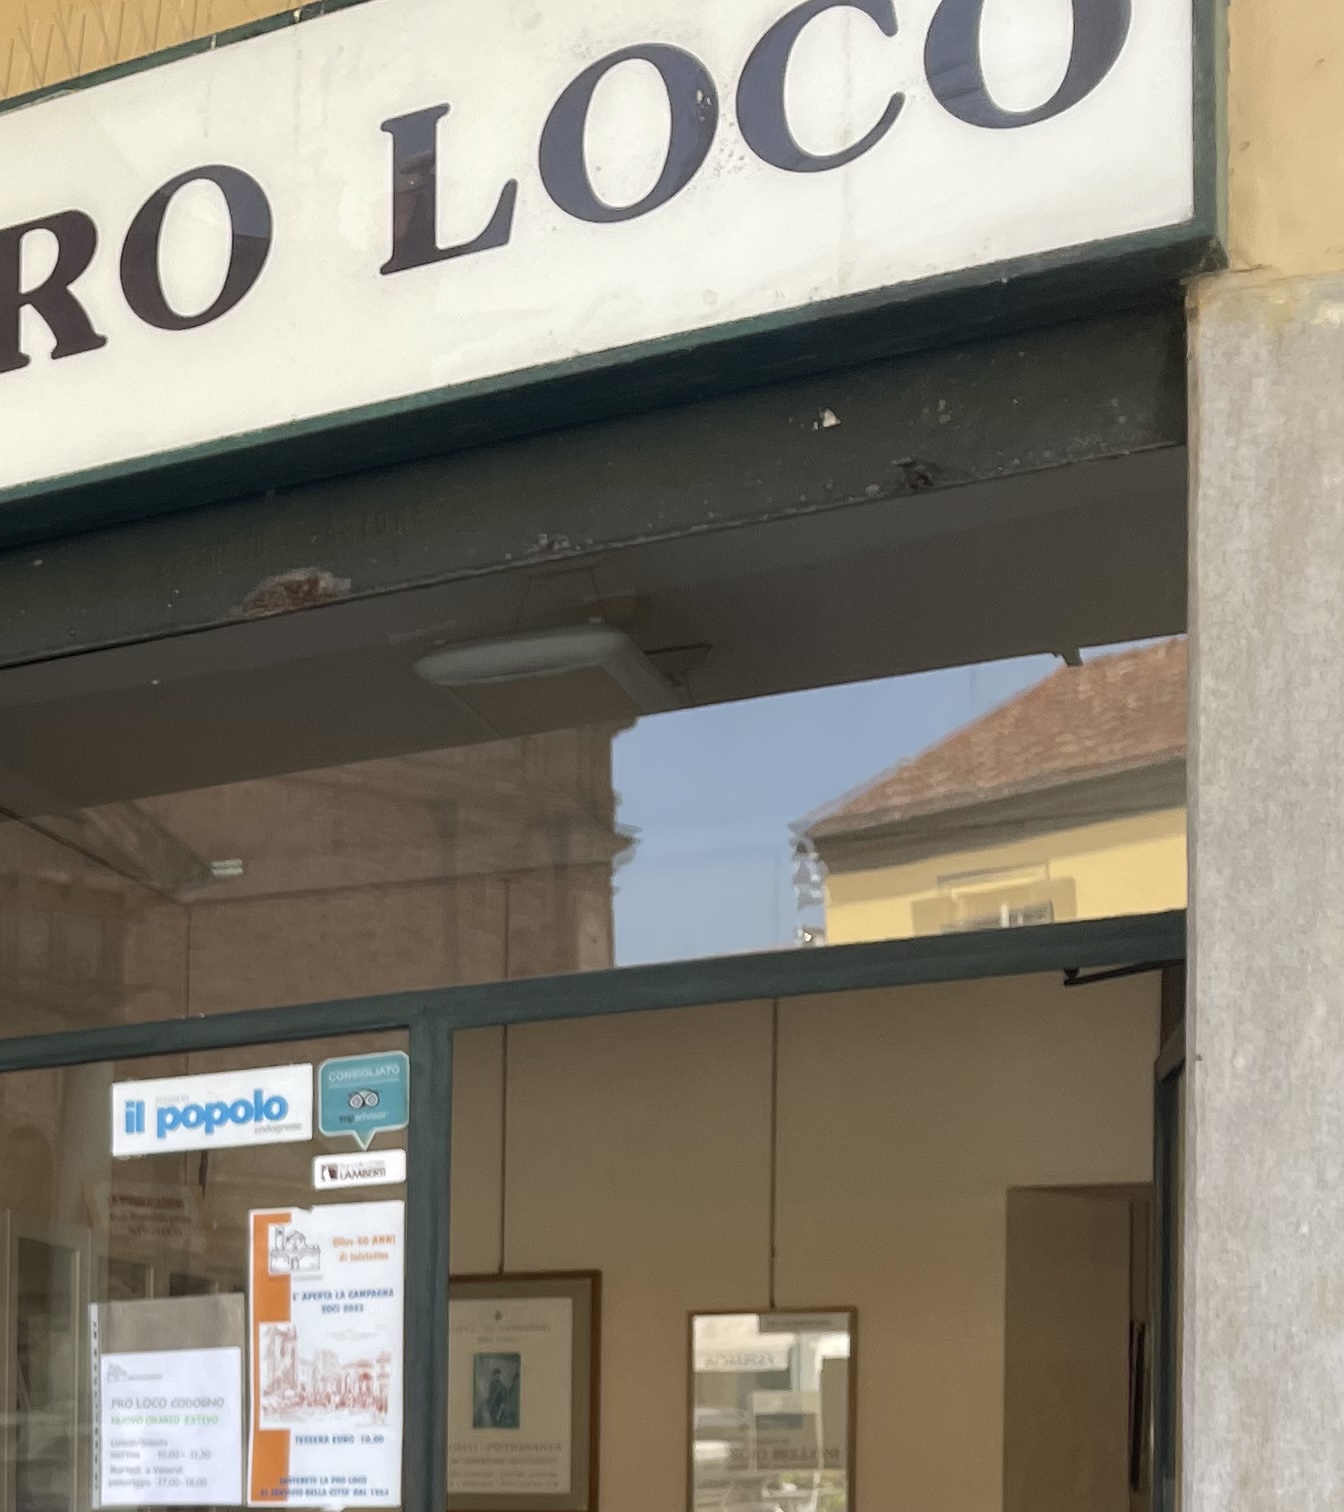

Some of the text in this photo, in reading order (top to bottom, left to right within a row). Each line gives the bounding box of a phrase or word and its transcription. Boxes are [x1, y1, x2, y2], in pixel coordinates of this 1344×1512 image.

[380, 0, 1132, 276] LOCO
[328, 1065, 400, 1082] CONSIGLIATO
[125, 1088, 289, 1139] il popolo
[111, 1398, 133, 1409] PRO
[136, 1397, 167, 1409] LOCO
